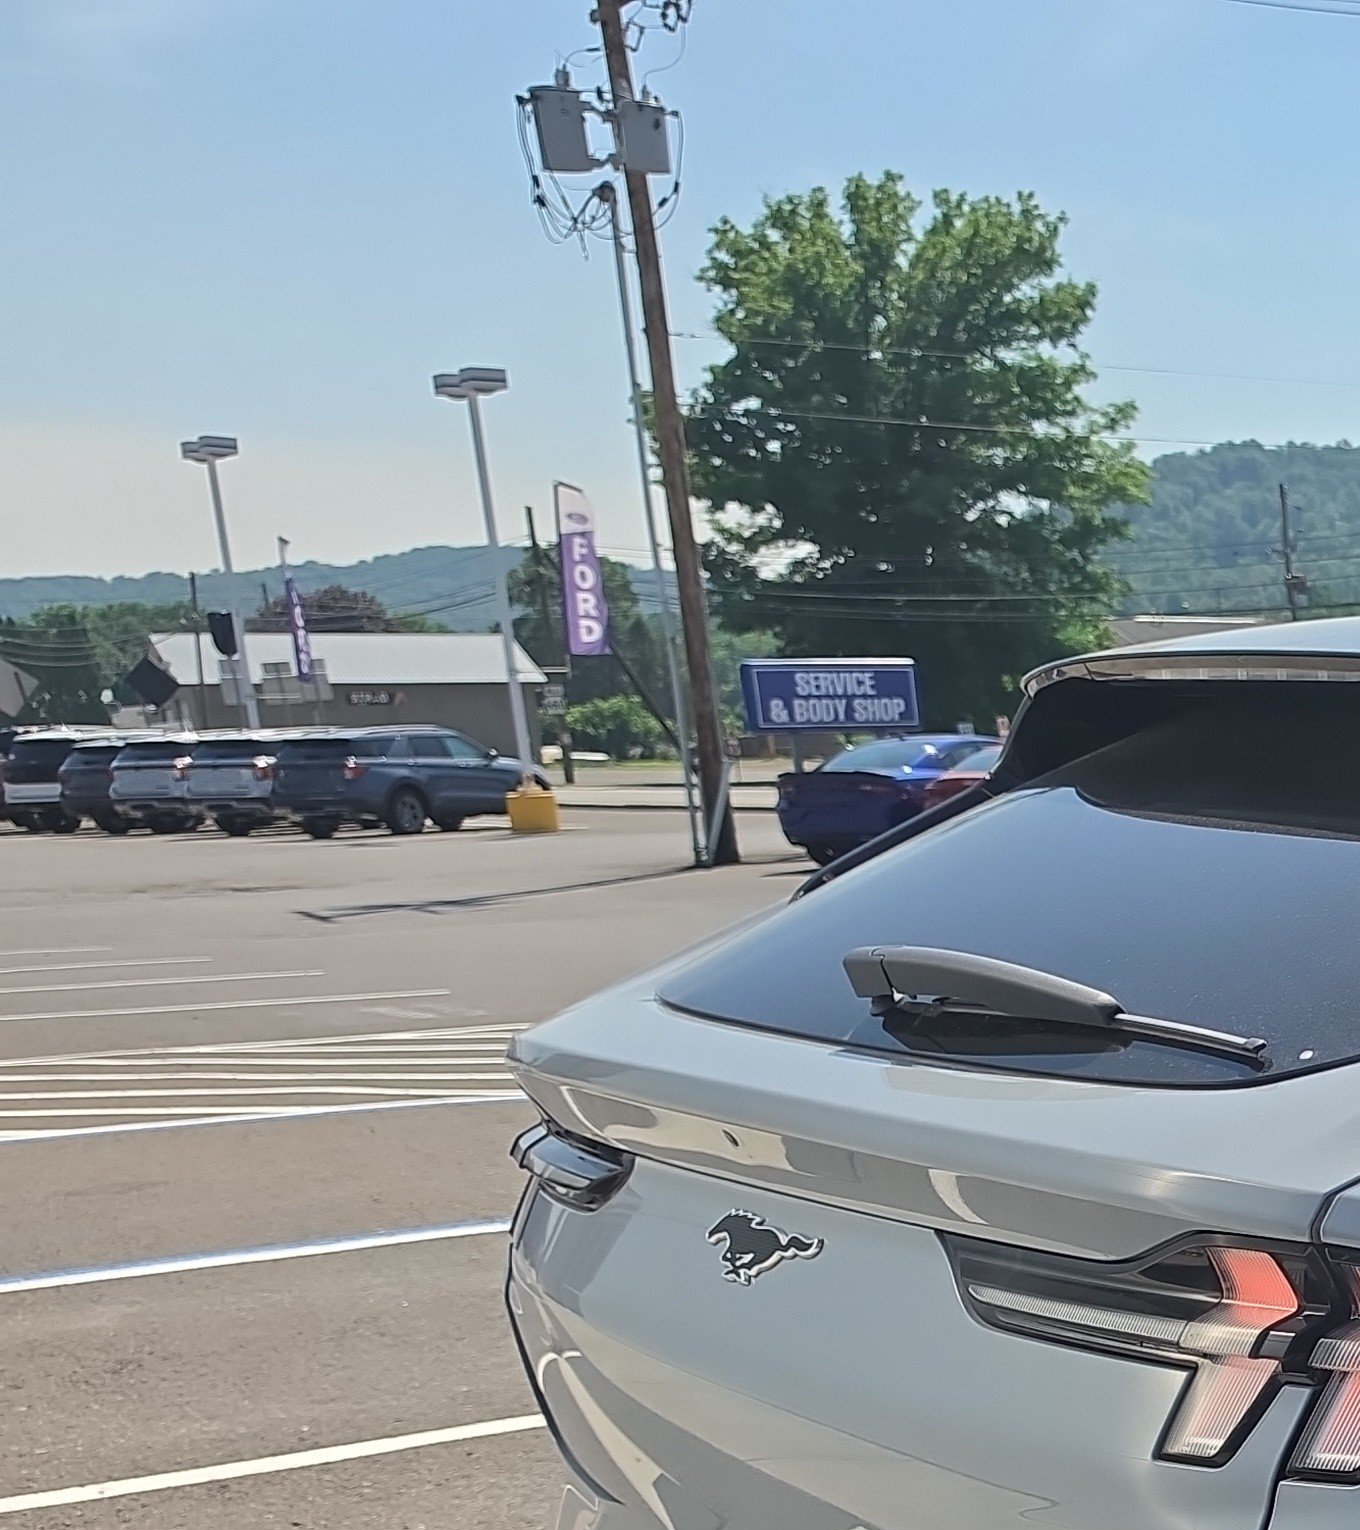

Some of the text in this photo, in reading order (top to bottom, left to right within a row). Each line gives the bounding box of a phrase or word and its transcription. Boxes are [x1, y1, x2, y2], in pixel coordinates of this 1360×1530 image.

[573, 538, 603, 644] FORD
[794, 672, 876, 696] SERVICE
[770, 697, 906, 723] & BODY SHOP
